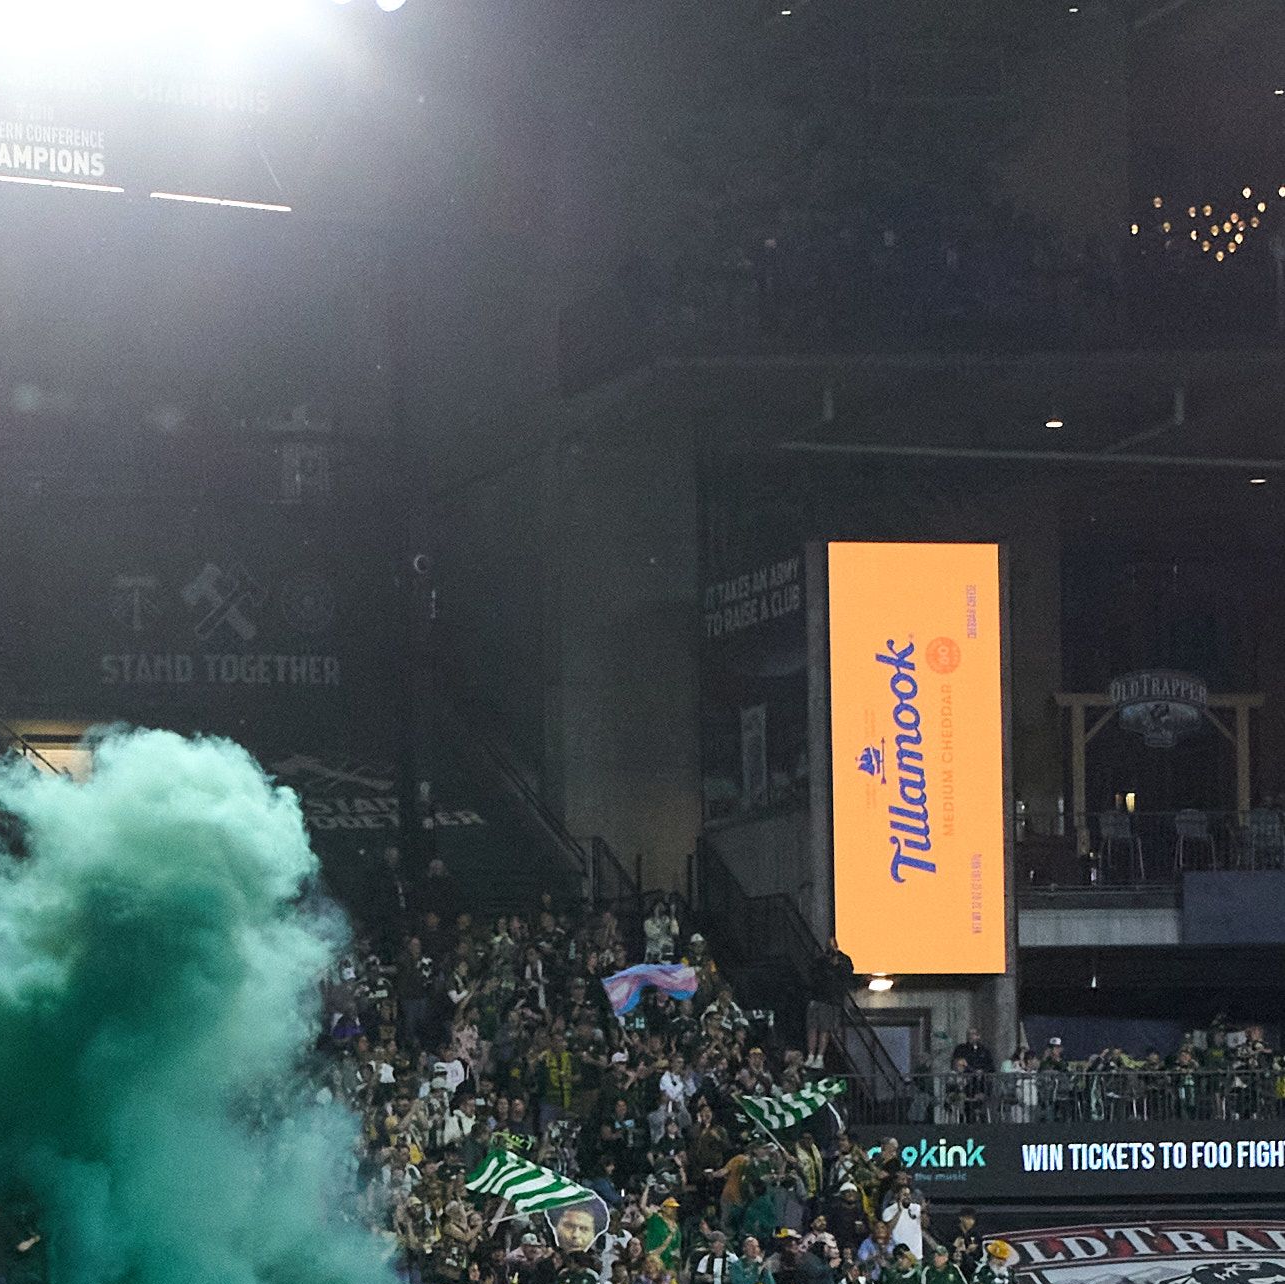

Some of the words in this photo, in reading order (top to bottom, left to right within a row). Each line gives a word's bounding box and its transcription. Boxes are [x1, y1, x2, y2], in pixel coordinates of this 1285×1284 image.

[25, 123, 105, 150] CONFERENCE
[100, 653, 194, 684] STAND
[202, 653, 341, 687] TOGETHER
[941, 684, 954, 764] CHEDDAR
[874, 637, 937, 884] Tillamook
[942, 769, 956, 837] MEDIUM
[1022, 1144, 1063, 1171] WIN
[1069, 1142, 1155, 1170] TICKETS
[1159, 1142, 1187, 1169] TO
[1191, 1141, 1232, 1168] FOO
